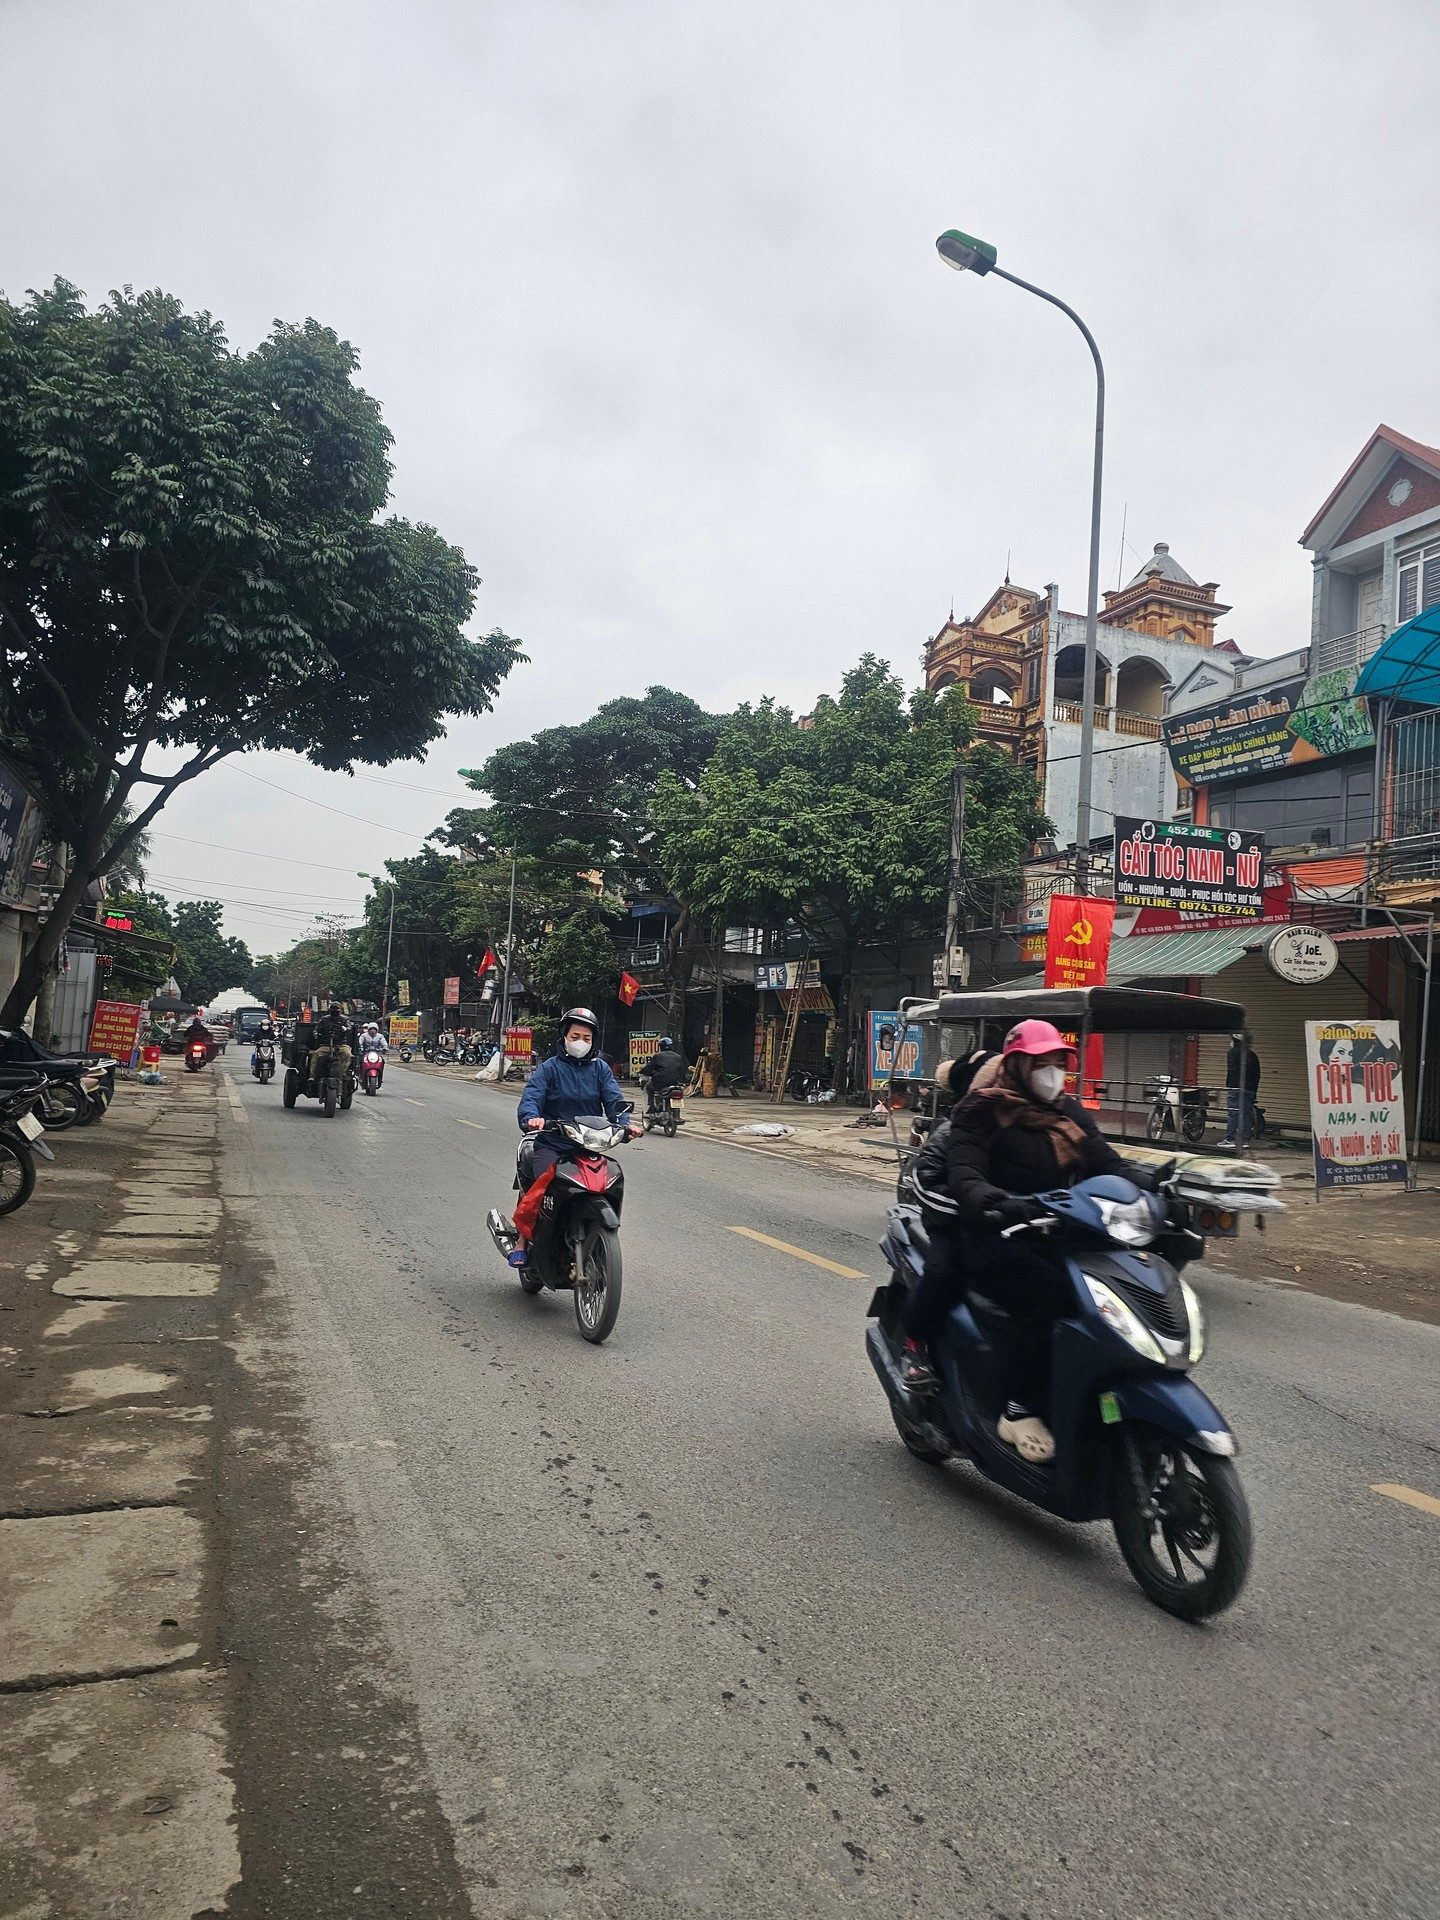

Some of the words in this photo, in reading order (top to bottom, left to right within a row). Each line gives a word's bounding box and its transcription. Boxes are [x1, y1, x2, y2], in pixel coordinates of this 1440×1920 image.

[1178, 755, 1189, 766] XE
[1167, 825, 1189, 836] 452
[1191, 827, 1214, 838] JOE
[1120, 829, 1152, 878] CẮT
[1153, 837, 1185, 881] TÓC
[1186, 846, 1224, 885] NAM
[1236, 845, 1262, 889] NỮ
[1124, 895, 1177, 909] HOTLINE:
[1179, 900, 1257, 917] 0974.162.744
[1286, 929, 1302, 938] HAIR
[1303, 929, 1323, 938] SALON
[631, 1056, 653, 1065] COP
[1315, 1056, 1354, 1105] CẮT
[1360, 1056, 1400, 1104] TÓC
[1327, 1111, 1357, 1126] NAM
[1369, 1106, 1390, 1124] NỮ
